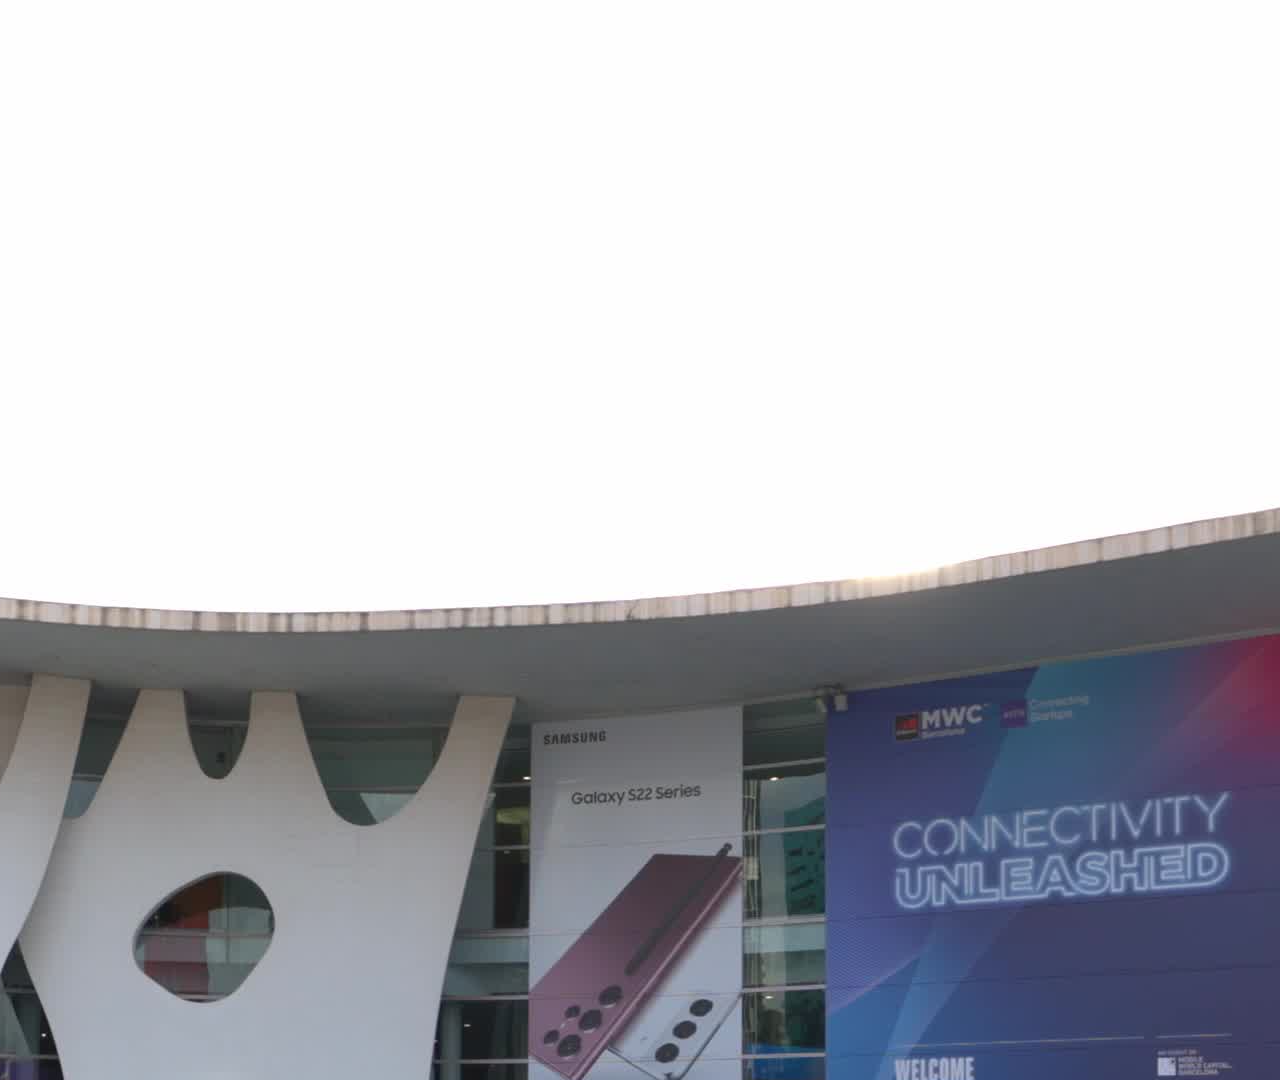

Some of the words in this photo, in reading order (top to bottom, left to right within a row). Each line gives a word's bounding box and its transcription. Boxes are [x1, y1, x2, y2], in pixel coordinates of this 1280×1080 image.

[922, 704, 983, 729] MWC
[543, 730, 607, 745] SAMSUNG
[571, 790, 625, 806] Galaxy
[628, 788, 653, 801] S22
[655, 784, 701, 800] Series
[893, 791, 1230, 858] CONNECTIVITY
[895, 843, 1231, 908] UNLEASHED
